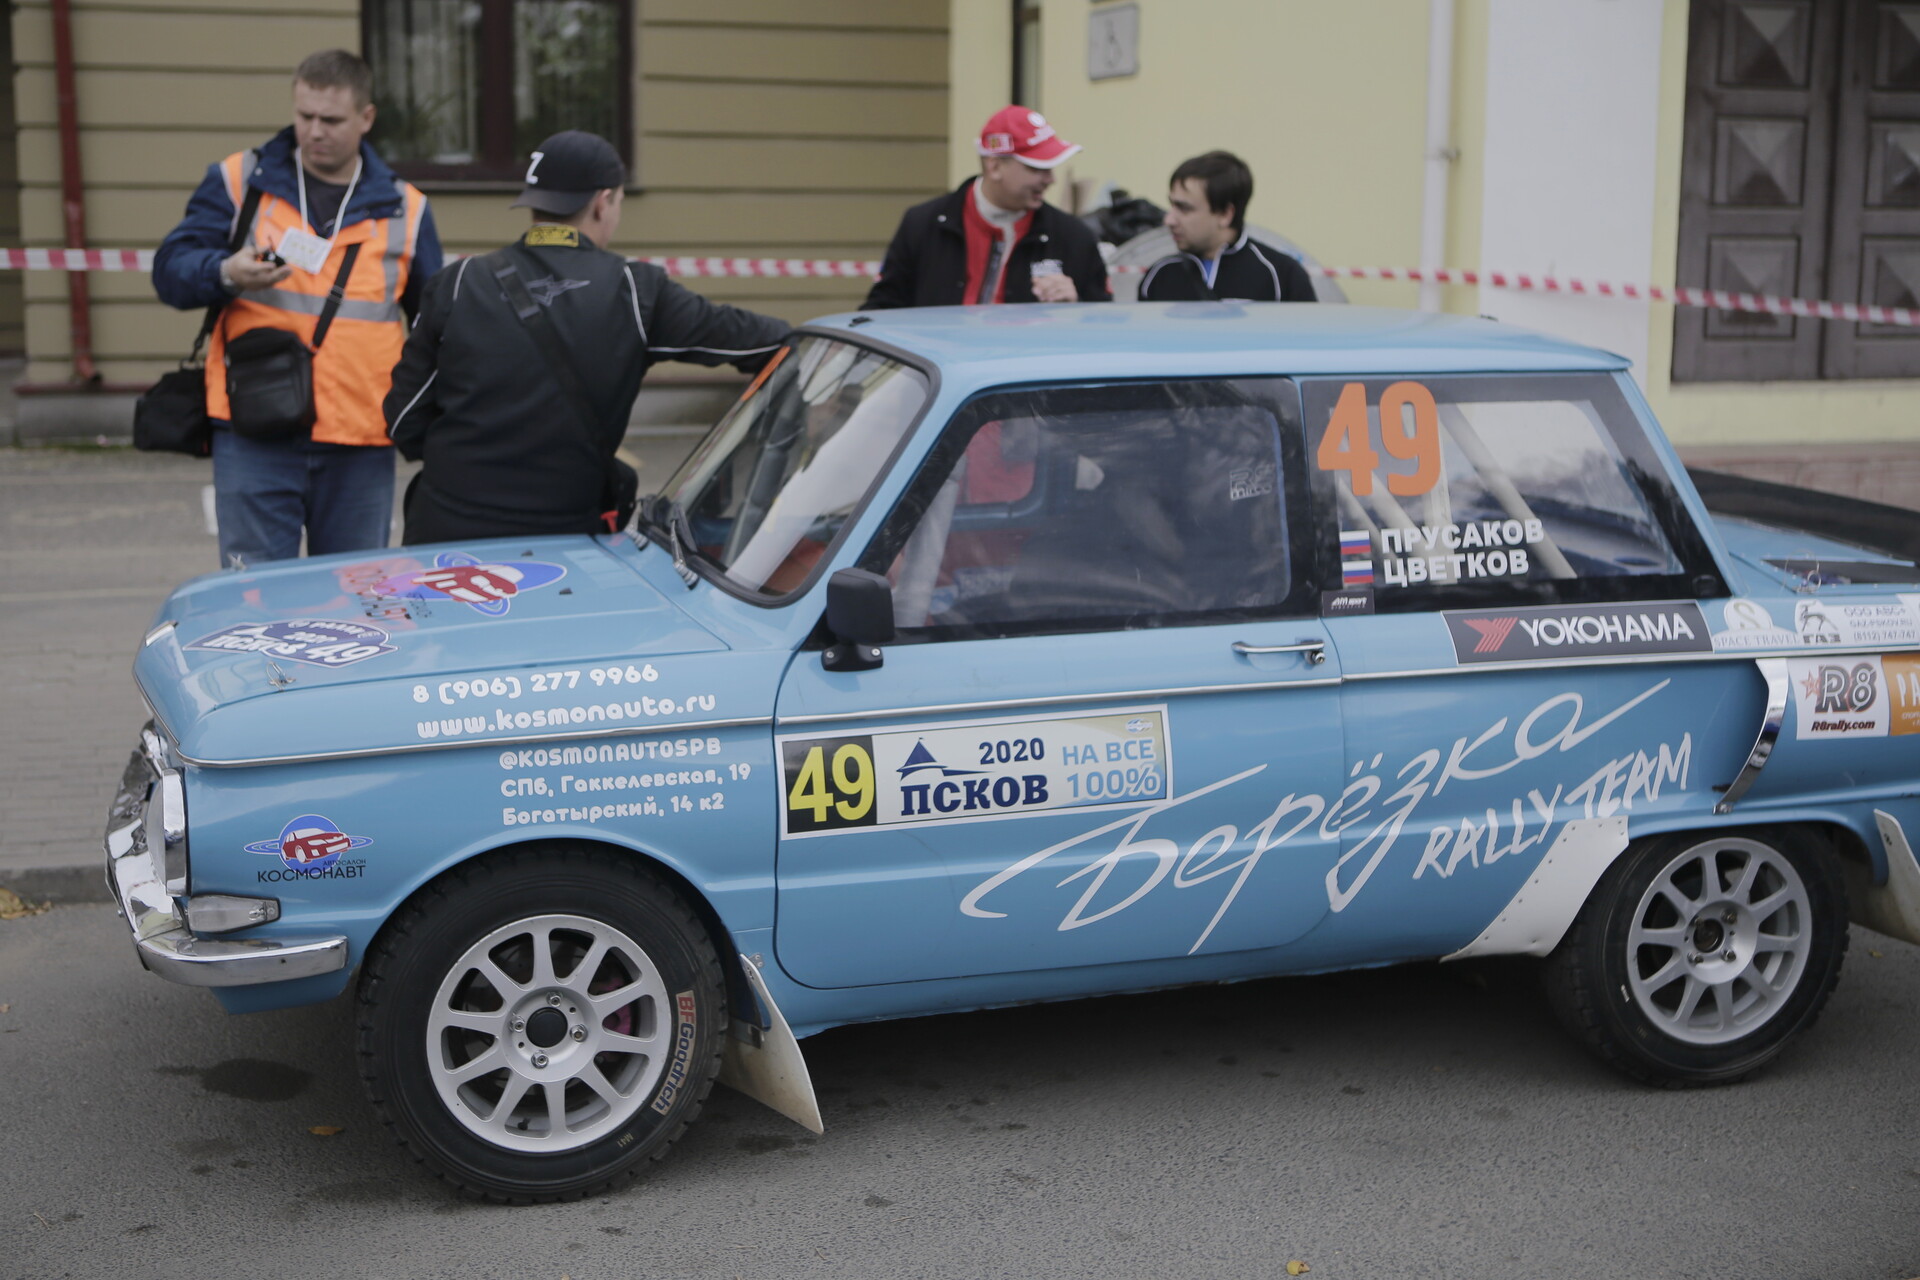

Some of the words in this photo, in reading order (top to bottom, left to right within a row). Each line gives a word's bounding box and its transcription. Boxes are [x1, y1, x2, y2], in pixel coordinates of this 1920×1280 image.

[525, 151, 545, 186] Z
[1317, 380, 1441, 497] 49
[1381, 518, 1545, 554] ПРУСАКОВ
[1382, 549, 1530, 588] ЦВЕТКОВ
[1518, 612, 1696, 648] YOKOHAMA
[304, 642, 381, 663] 49
[413, 684, 430, 703] 8
[438, 676, 522, 706] (906)
[530, 670, 581, 693] 277
[589, 664, 659, 687] 9966
[1814, 662, 1878, 714] R8
[416, 694, 717, 740] www.kosmonauto.ru
[1811, 719, 1876, 732] R8rally.com
[979, 737, 1046, 765] 2020
[1062, 744, 1099, 767] НА
[1106, 738, 1155, 763] ВСЕ
[501, 777, 555, 798] СПб,
[560, 769, 725, 794] Гаккелевская,
[729, 763, 752, 782] 19
[787, 743, 876, 824] 49
[900, 774, 1050, 817] ПСКОВ
[1066, 765, 1161, 799] 100%
[503, 796, 666, 827] Богатырский,
[670, 794, 694, 813] 14
[699, 792, 725, 812] к2
[960, 678, 1671, 955] Берёзка
[1412, 783, 1564, 880] RALLY
[1563, 731, 1692, 820] TEAM
[257, 865, 367, 883] КОСМОНАВТ
[655, 996, 695, 1112] BFGoodrich
